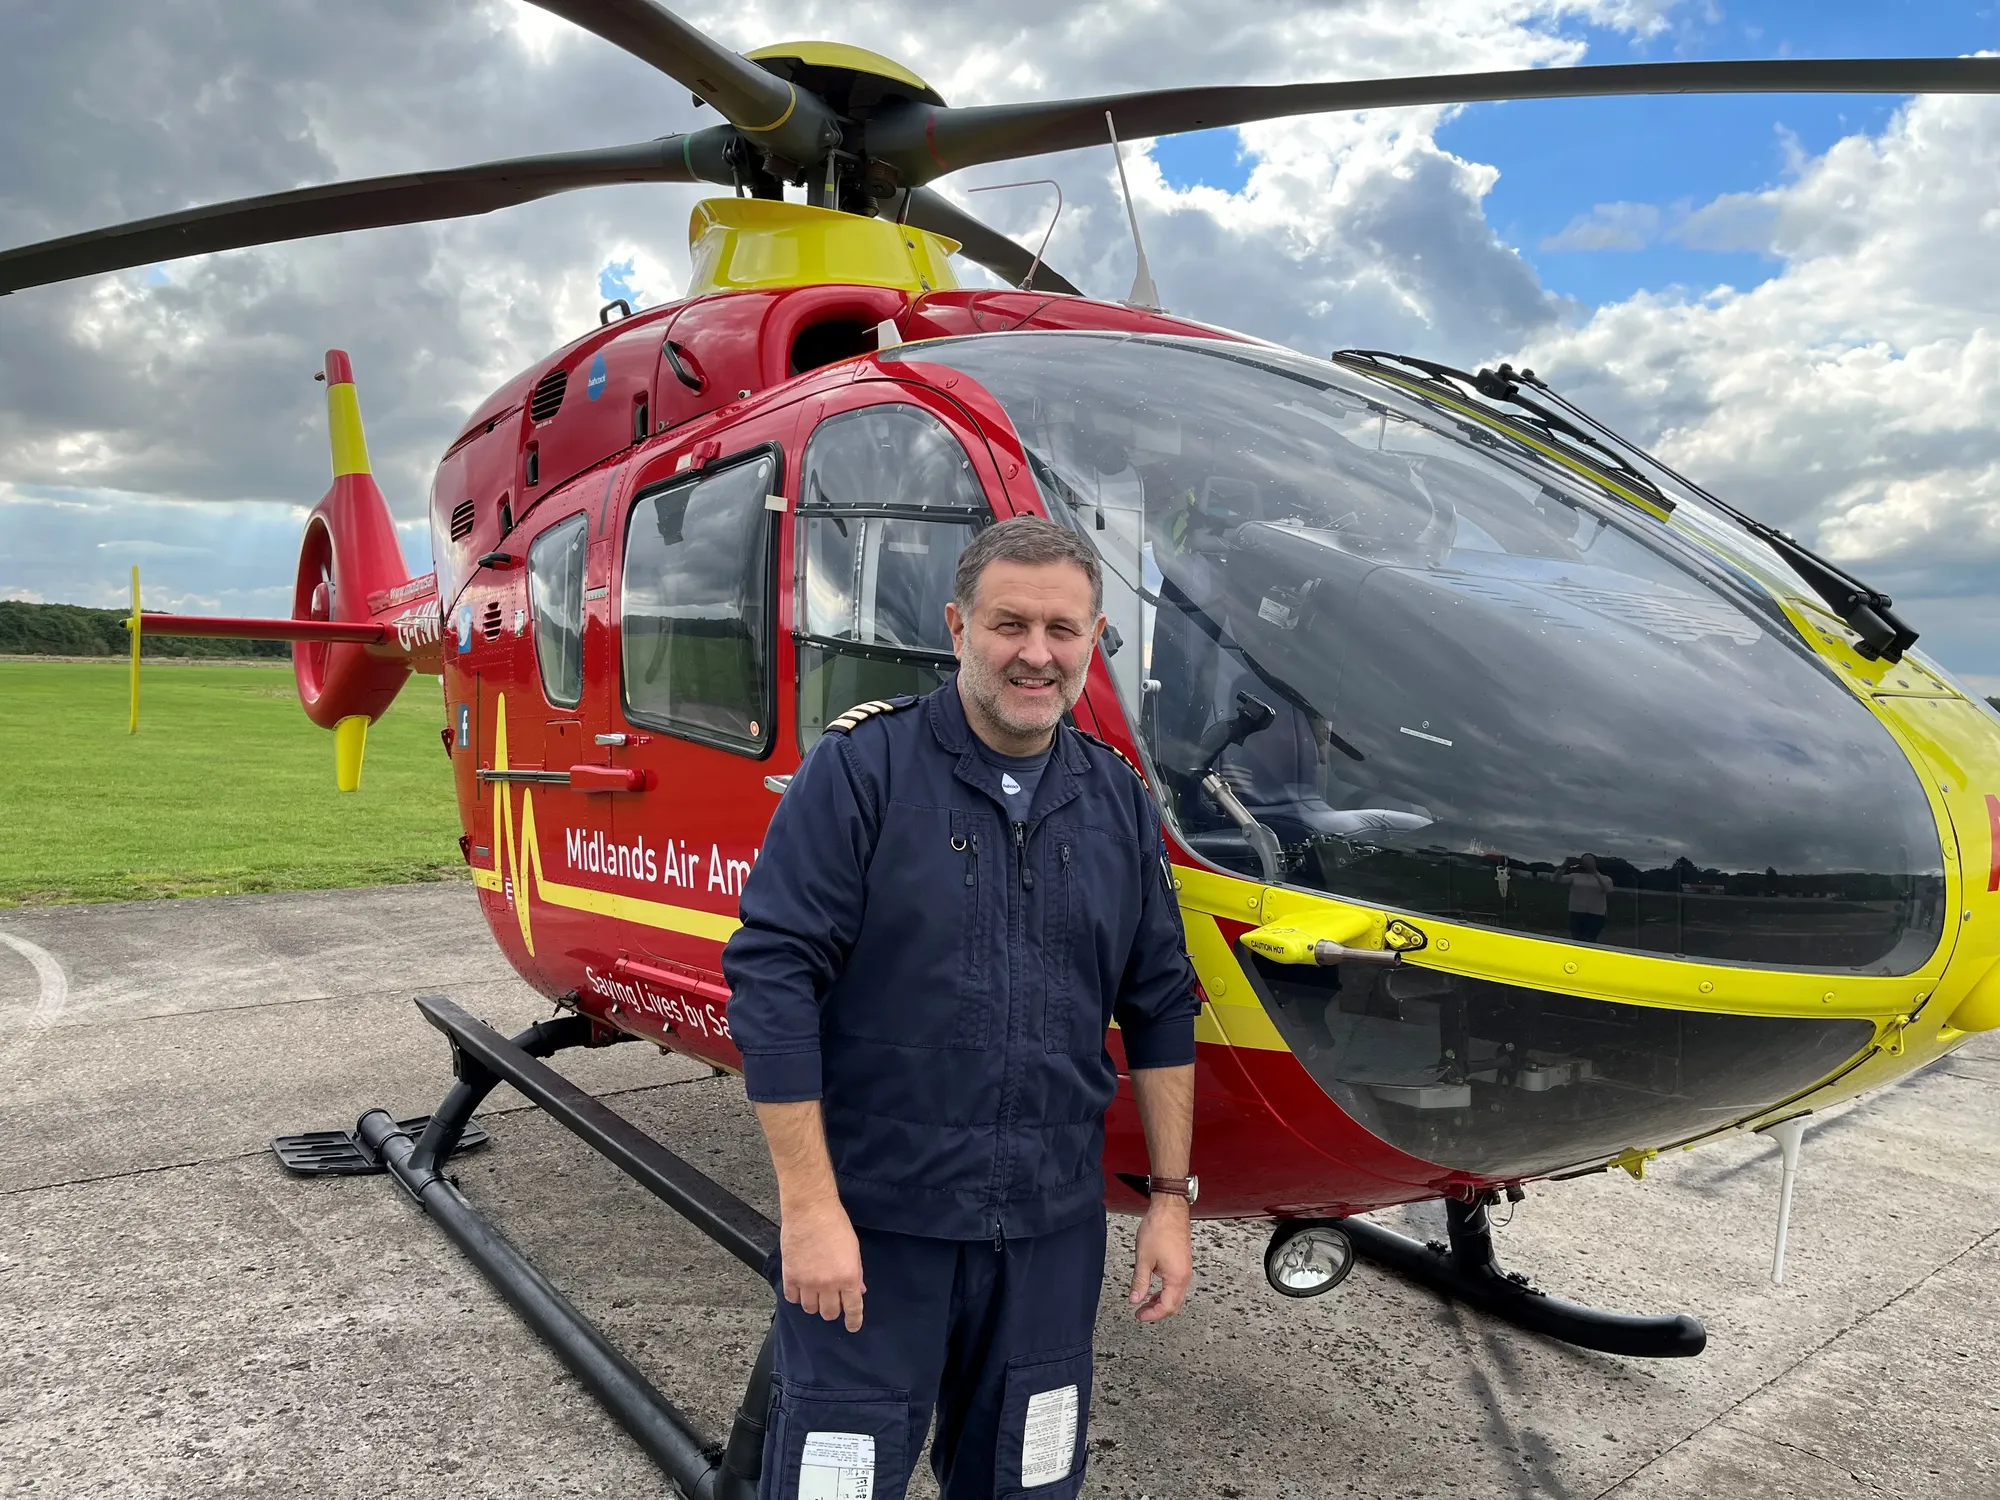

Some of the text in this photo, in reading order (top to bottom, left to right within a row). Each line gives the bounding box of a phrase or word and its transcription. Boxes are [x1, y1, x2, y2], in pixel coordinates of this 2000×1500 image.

[588, 374, 606, 387] babcock
[566, 827, 759, 897] Midlands Air Am
[1250, 940, 1285, 955] CAUTION HOT
[585, 966, 642, 1014] Saving
[635, 981, 684, 1023] Lives
[681, 995, 709, 1037] by
